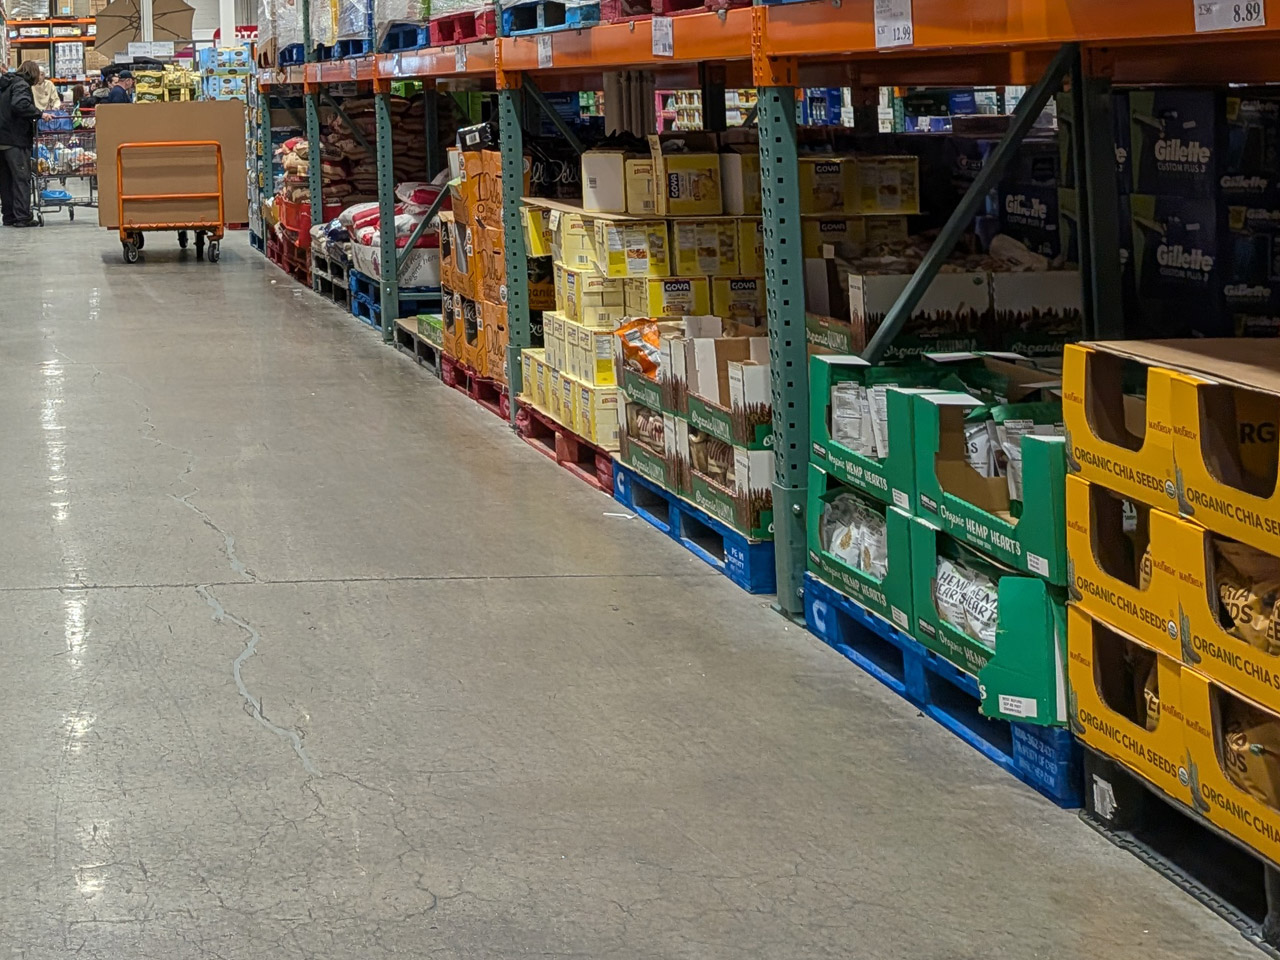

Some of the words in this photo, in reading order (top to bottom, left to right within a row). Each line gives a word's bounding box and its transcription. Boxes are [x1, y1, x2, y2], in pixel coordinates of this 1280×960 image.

[1233, 2, 1261, 23] 8.89
[892, 25, 912, 41] 12.99
[1154, 139, 1211, 164] Gillette
[816, 165, 840, 173] GOYA
[1157, 163, 1182, 172] CUSTOM
[1183, 163, 1199, 173] PLUS
[1200, 164, 1206, 173] 3
[671, 174, 679, 198] GOYA
[1005, 194, 1047, 219] Gillette
[1156, 244, 1215, 272] Gillette
[664, 283, 690, 291] GOYA
[731, 282, 757, 290] GOYA
[1184, 270, 1201, 281] PLUS
[1202, 271, 1209, 282] 3
[845, 460, 863, 478] HEMP
[864, 469, 888, 491] HEARTS
[1074, 446, 1113, 472] ORGANIC
[1113, 462, 1136, 482] CHIA
[1137, 470, 1165, 494] SEEDS
[1186, 487, 1235, 520] ORGANIC
[1235, 506, 1265, 532] CHIA
[940, 505, 965, 529] Organic
[966, 518, 989, 540] HEMP
[990, 529, 1022, 556] HEARTS
[842, 572, 860, 591] HEMP
[861, 583, 887, 608] HEARTS
[1076, 575, 1116, 607] ORGANIC
[1117, 595, 1140, 618] CHIA
[1140, 608, 1167, 634] SEEDS
[938, 629, 964, 655] Organic
[964, 644, 988, 668] HEMP
[1193, 634, 1243, 672] ORGANIC
[1243, 657, 1271, 687] CHIA
[1079, 708, 1122, 745] ORGANIC
[1122, 735, 1146, 760] CHIA
[1147, 749, 1178, 780] SEEDS
[1201, 783, 1253, 828] ORGANIC
[1253, 815, 1280, 844] CHIA
